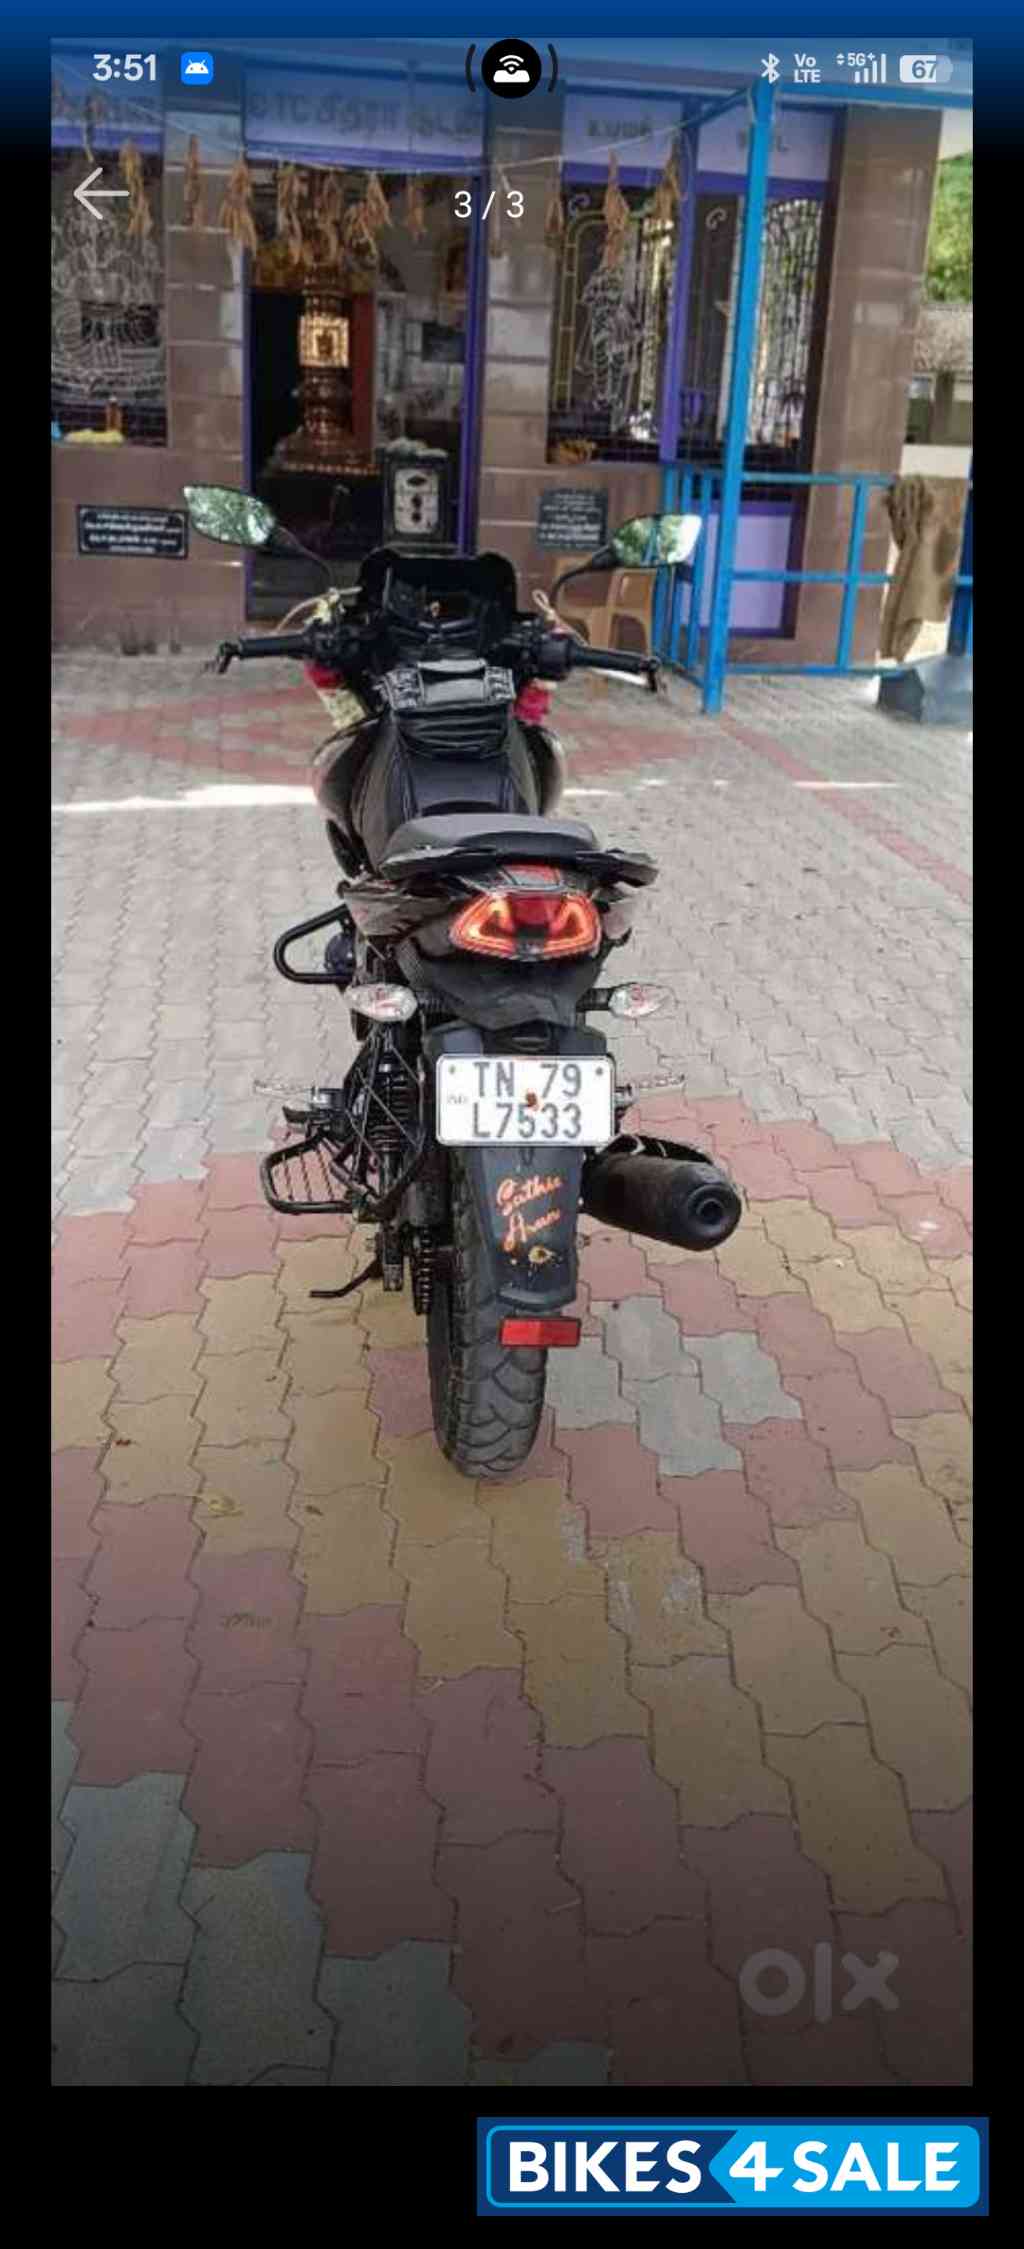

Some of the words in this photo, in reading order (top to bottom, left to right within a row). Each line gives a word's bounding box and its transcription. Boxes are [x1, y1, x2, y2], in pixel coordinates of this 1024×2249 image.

[473, 1061, 515, 1098] TN
[540, 1063, 582, 1098] 79
[472, 1102, 582, 1139] L7533
